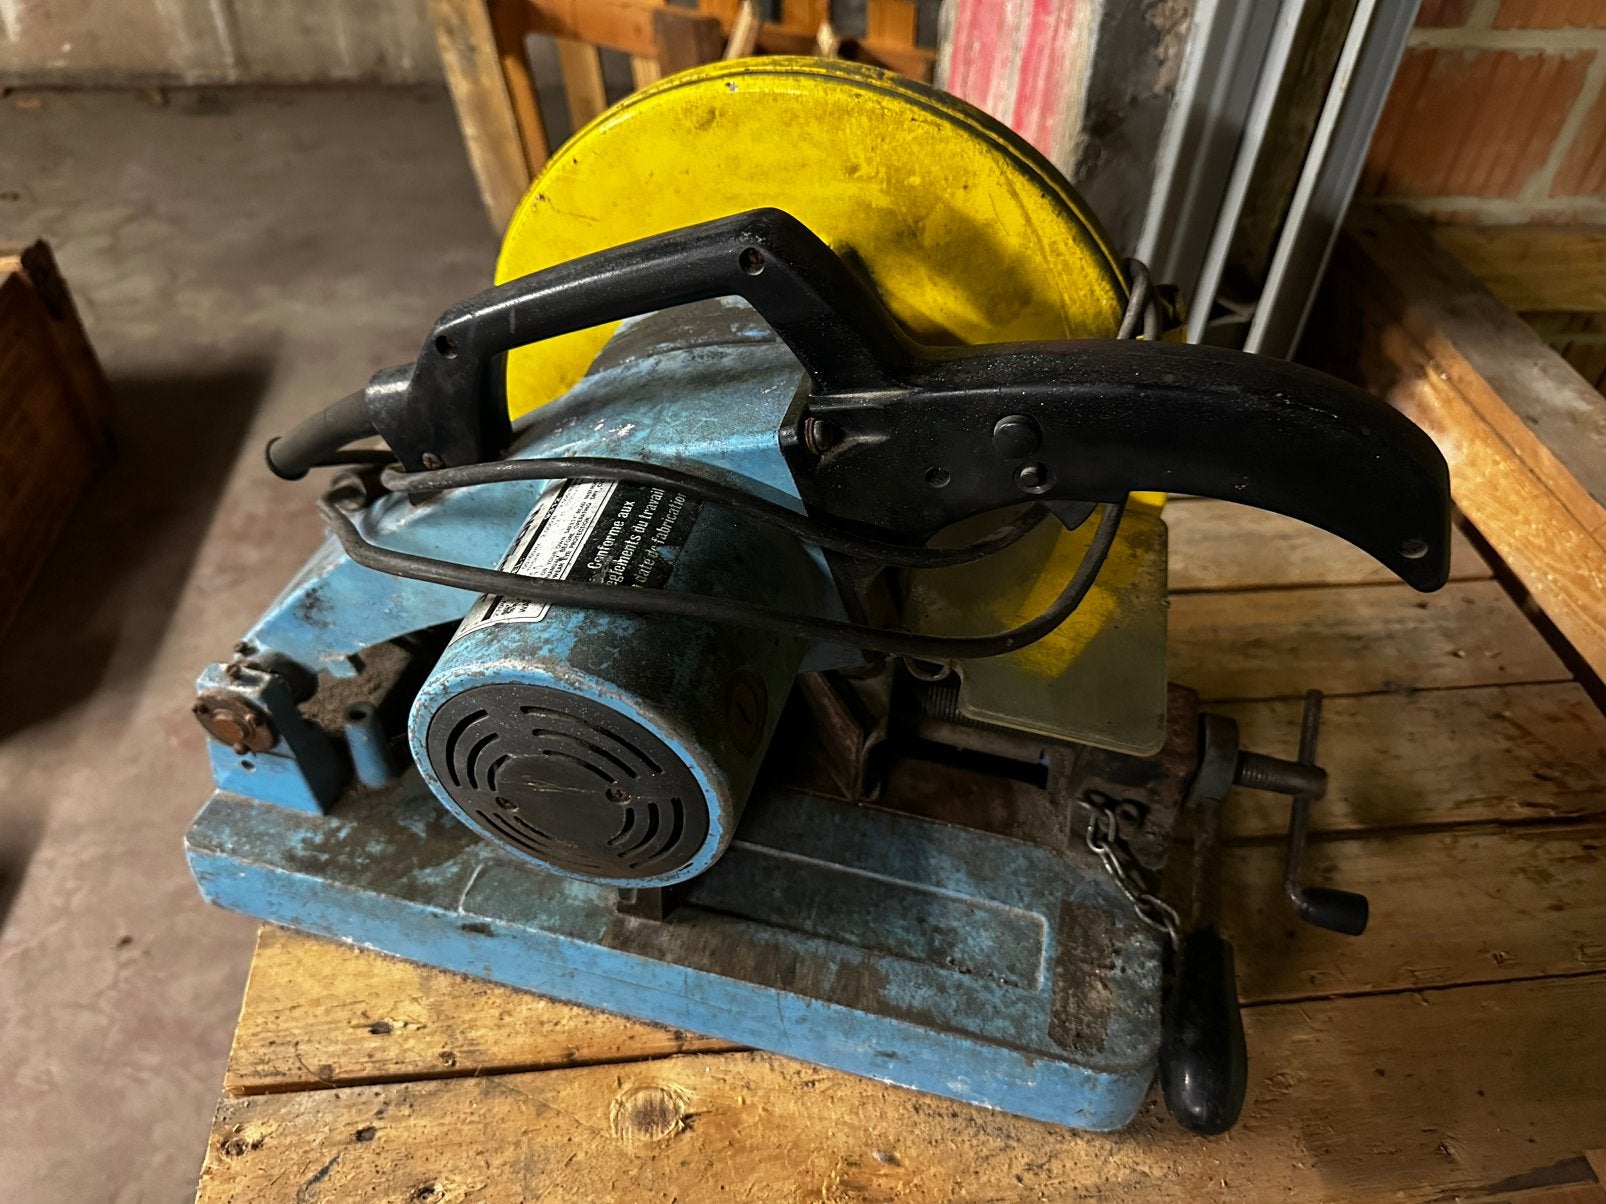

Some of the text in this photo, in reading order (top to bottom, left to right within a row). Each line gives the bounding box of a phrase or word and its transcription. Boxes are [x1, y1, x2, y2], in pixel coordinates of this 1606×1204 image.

[638, 487, 665, 520] travail
[587, 500, 635, 570] Conforme aux
[631, 520, 649, 533] du
[601, 534, 642, 586] èglements
[633, 556, 656, 583] date
